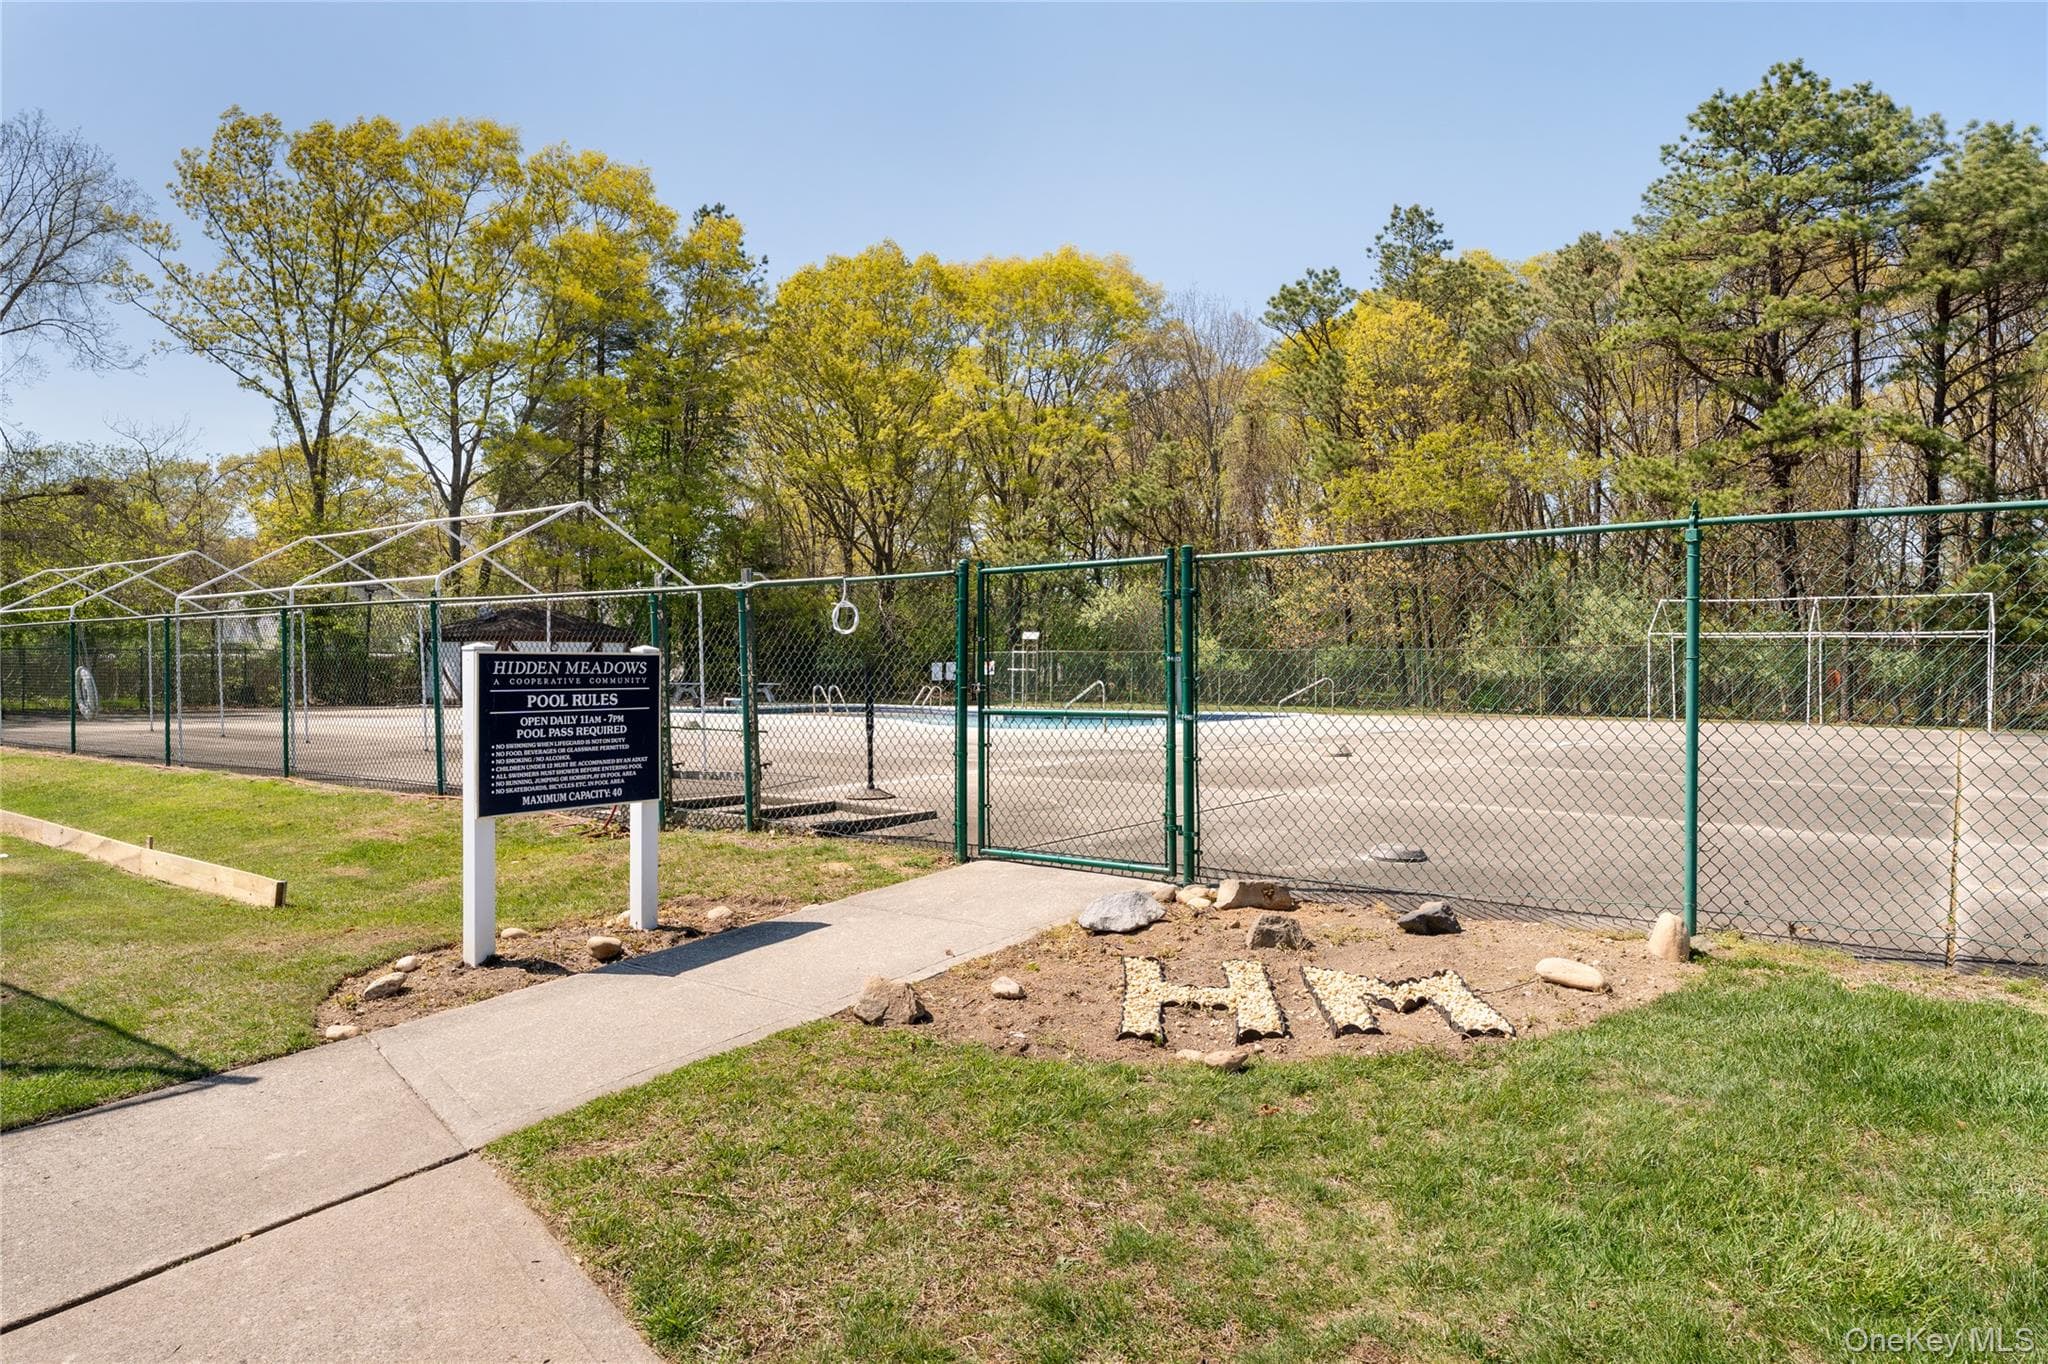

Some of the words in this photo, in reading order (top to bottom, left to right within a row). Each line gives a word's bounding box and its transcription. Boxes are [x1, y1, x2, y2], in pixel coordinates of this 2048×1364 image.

[492, 661, 561, 675] HIDDEN
[565, 661, 647, 674] MEADOWS
[527, 694, 568, 708] POOL
[572, 693, 618, 706] RULES
[520, 716, 548, 726] OPEN
[550, 715, 578, 726] DAILY
[580, 715, 601, 724] 11AM
[607, 714, 624, 723] 7PM
[516, 729, 546, 739] POOL
[548, 728, 573, 737] PASS
[576, 725, 627, 737] REQUIRED
[522, 792, 567, 805] MAXIMUM
[568, 790, 611, 802] CAPACITY:
[612, 788, 622, 797] 40
